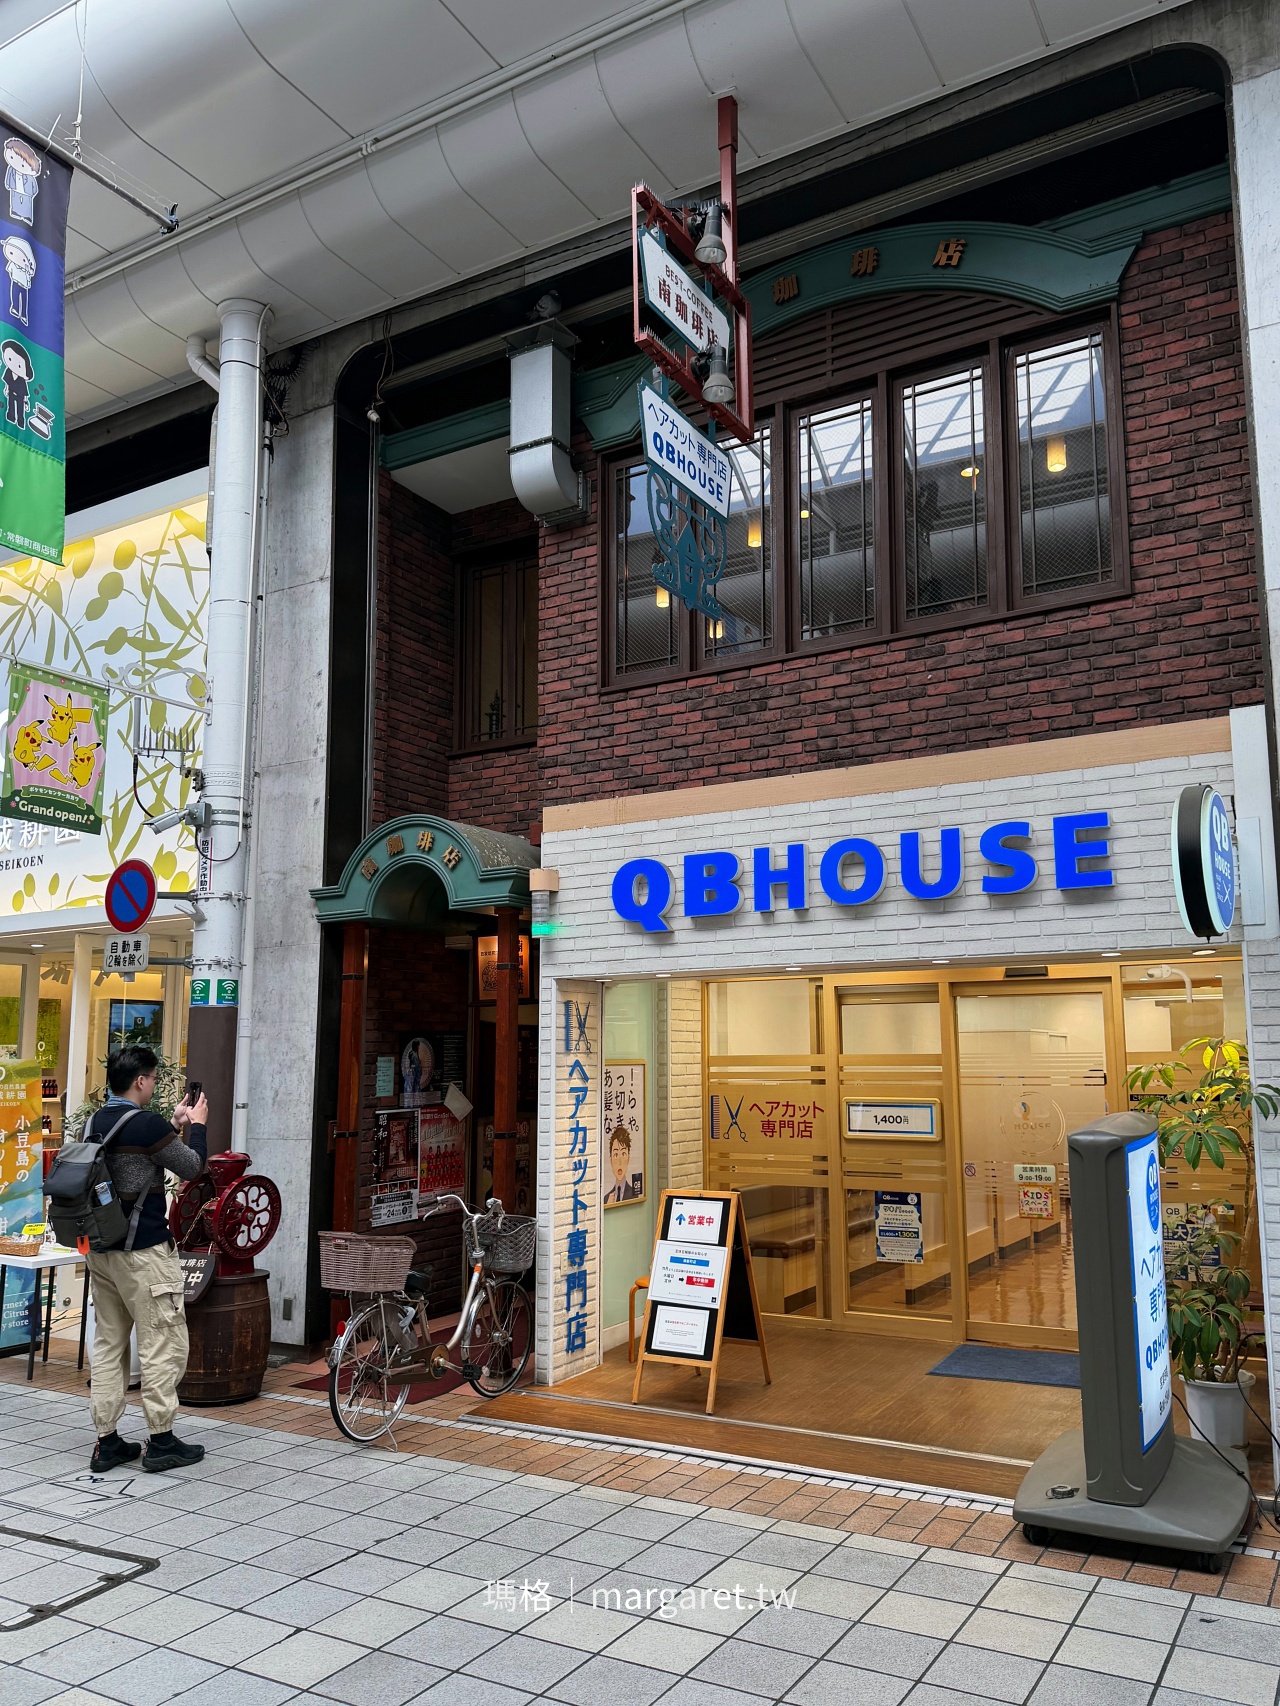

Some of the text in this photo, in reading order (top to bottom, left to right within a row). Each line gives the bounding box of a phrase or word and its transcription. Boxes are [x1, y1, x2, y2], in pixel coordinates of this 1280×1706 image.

[771, 237, 966, 306] 珈琲店
[665, 264, 714, 323] BEST-COFFEE
[657, 275, 719, 346] 南珈琲店
[648, 402, 727, 482] ヘアカット専門店
[652, 431, 724, 504] QBHOUSE
[19, 800, 89, 824] Grand open!
[1212, 805, 1230, 852] QB
[199, 839, 210, 892] 防犯カメラ作動中
[611, 811, 1115, 934] QBHOUSE
[1214, 850, 1232, 880] HOUSE
[105, 953, 145, 967] (2輪を除く)
[110, 940, 142, 954] 自動車
[748, 1100, 825, 1119] ヘアカット
[760, 1119, 814, 1139] 専門店
[14, 1114, 32, 1182] 小豆島の
[565, 1058, 590, 1354] ヘアカット専門店
[1022, 1190, 1050, 1200] KIDS
[1024, 1199, 1049, 1207] スペース
[687, 1215, 715, 1227] 営業中
[3, 1309, 29, 1319] Citrus
[8, 1319, 29, 1329] store
